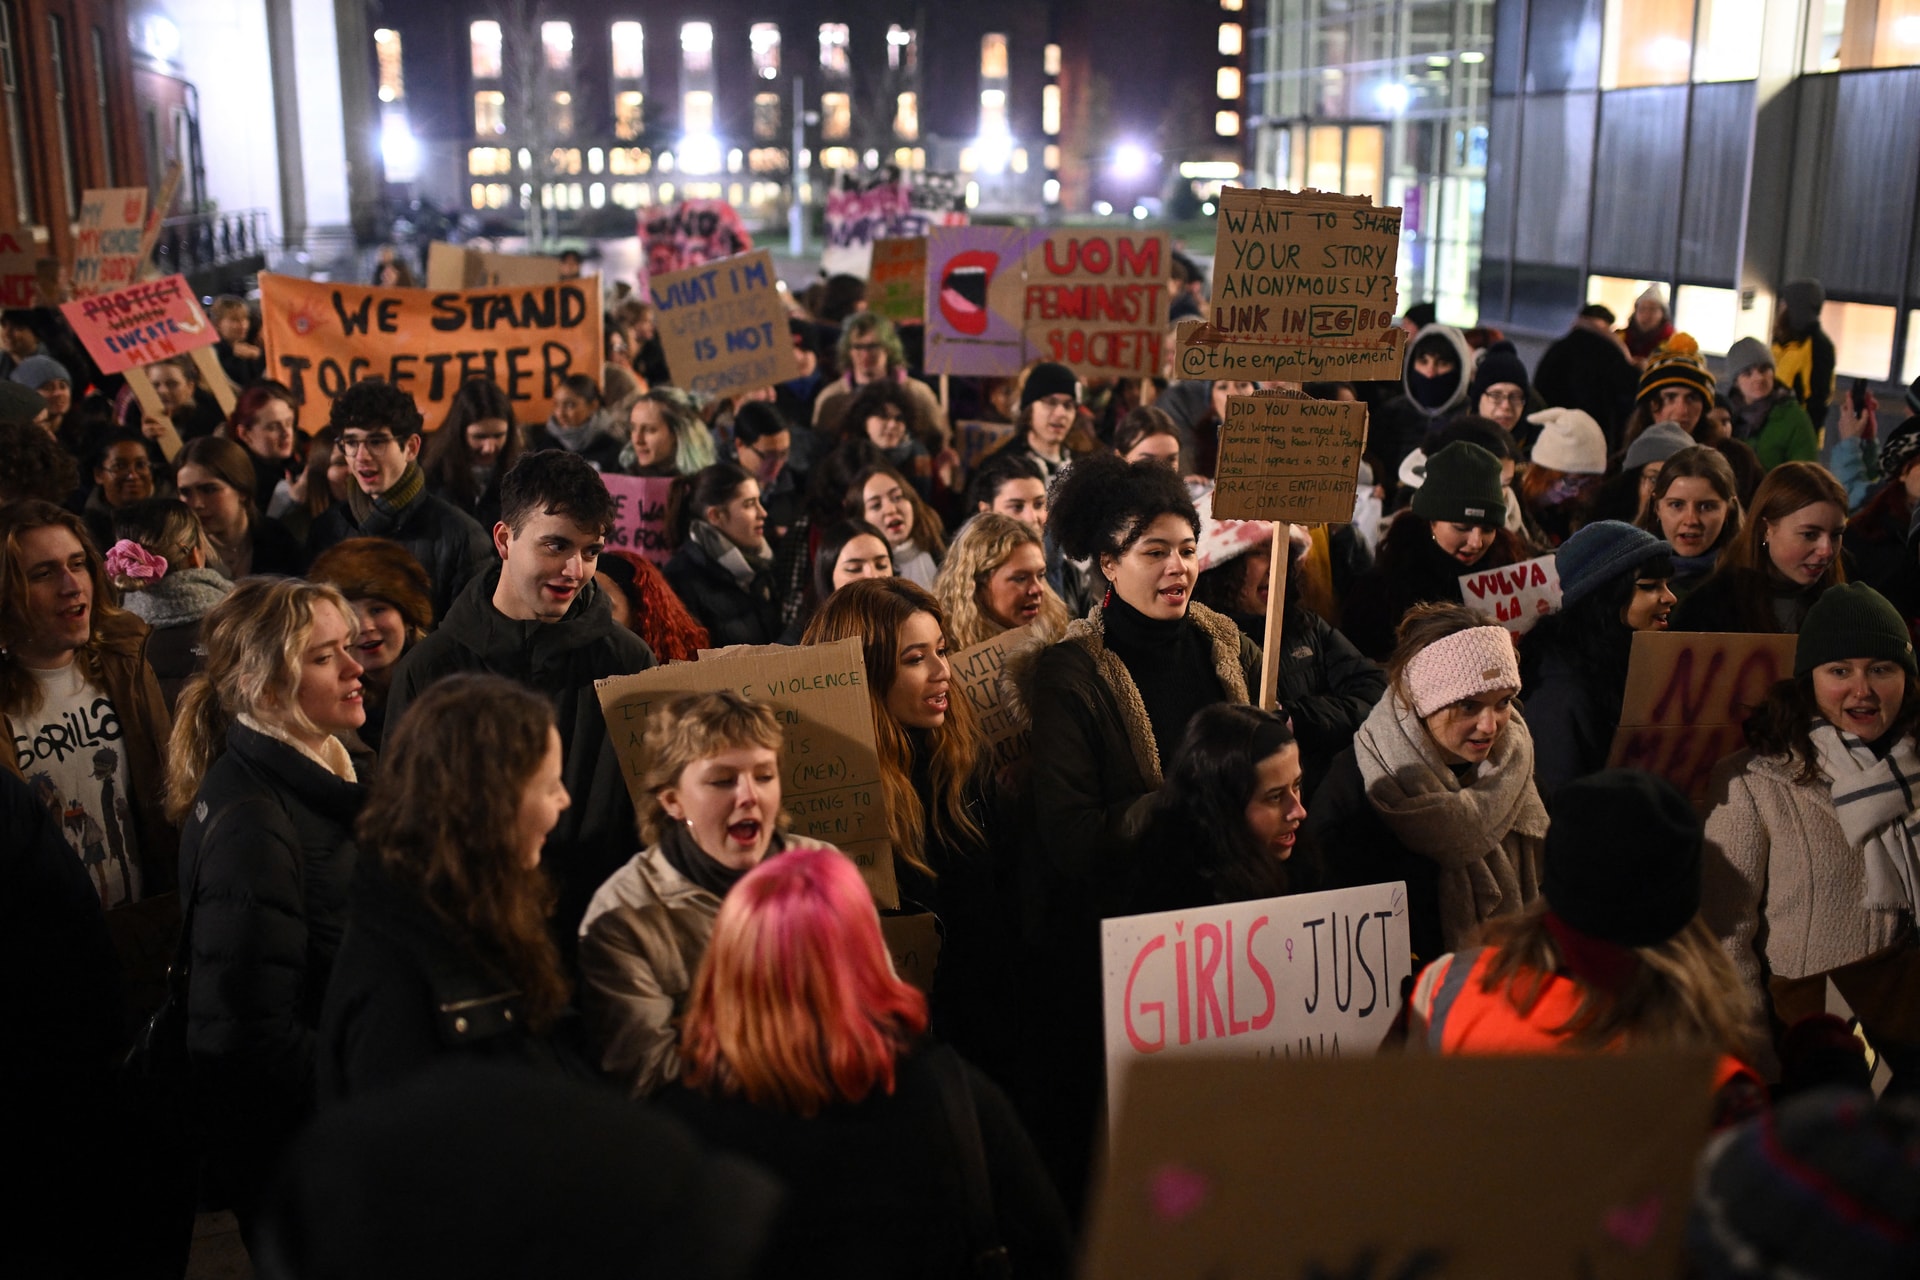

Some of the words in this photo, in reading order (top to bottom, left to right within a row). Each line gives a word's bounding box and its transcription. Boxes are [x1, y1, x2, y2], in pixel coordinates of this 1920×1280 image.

[1224, 208, 1294, 235] WANT
[1307, 212, 1337, 231] TO
[1352, 210, 1401, 236] SHARE
[1043, 237, 1162, 278] UOM
[1232, 239, 1301, 271] YOUR
[1322, 244, 1389, 270] STORY
[82, 278, 183, 323] PROTECT
[650, 270, 720, 312] WHAT
[1222, 273, 1393, 302] ANONYMOUSLY?
[331, 290, 403, 336] WE
[430, 285, 587, 331] STAND
[1025, 284, 1167, 324] FEMINIST
[1216, 304, 1270, 334] LINK
[1282, 308, 1307, 334] IN
[1313, 310, 1354, 332] IG
[1357, 308, 1392, 330] BIO
[104, 318, 181, 354] EDUCATE
[126, 338, 178, 366] MEN
[694, 337, 718, 362] IS
[725, 321, 773, 354] NOT
[1046, 329, 1163, 375] SOCIETY
[280, 340, 573, 406] TOGETHER
[1182, 346, 1396, 376] @theempathymovement
[1231, 402, 1256, 416] DID
[1264, 401, 1290, 416] YOU
[1266, 435, 1286, 450] they
[1310, 424, 1334, 438] raped
[1339, 424, 1352, 439] by
[1264, 457, 1299, 469] appears
[1303, 457, 1312, 465] in
[1218, 480, 1280, 494] PRACTICE
[1467, 562, 1547, 600] VULVA
[1495, 596, 1523, 623] LA
[953, 643, 1007, 682] WITH
[767, 671, 861, 697] VIOLENCE
[792, 755, 856, 790] (MEN).
[854, 791, 871, 807] TO
[1302, 911, 1393, 1018] JUST
